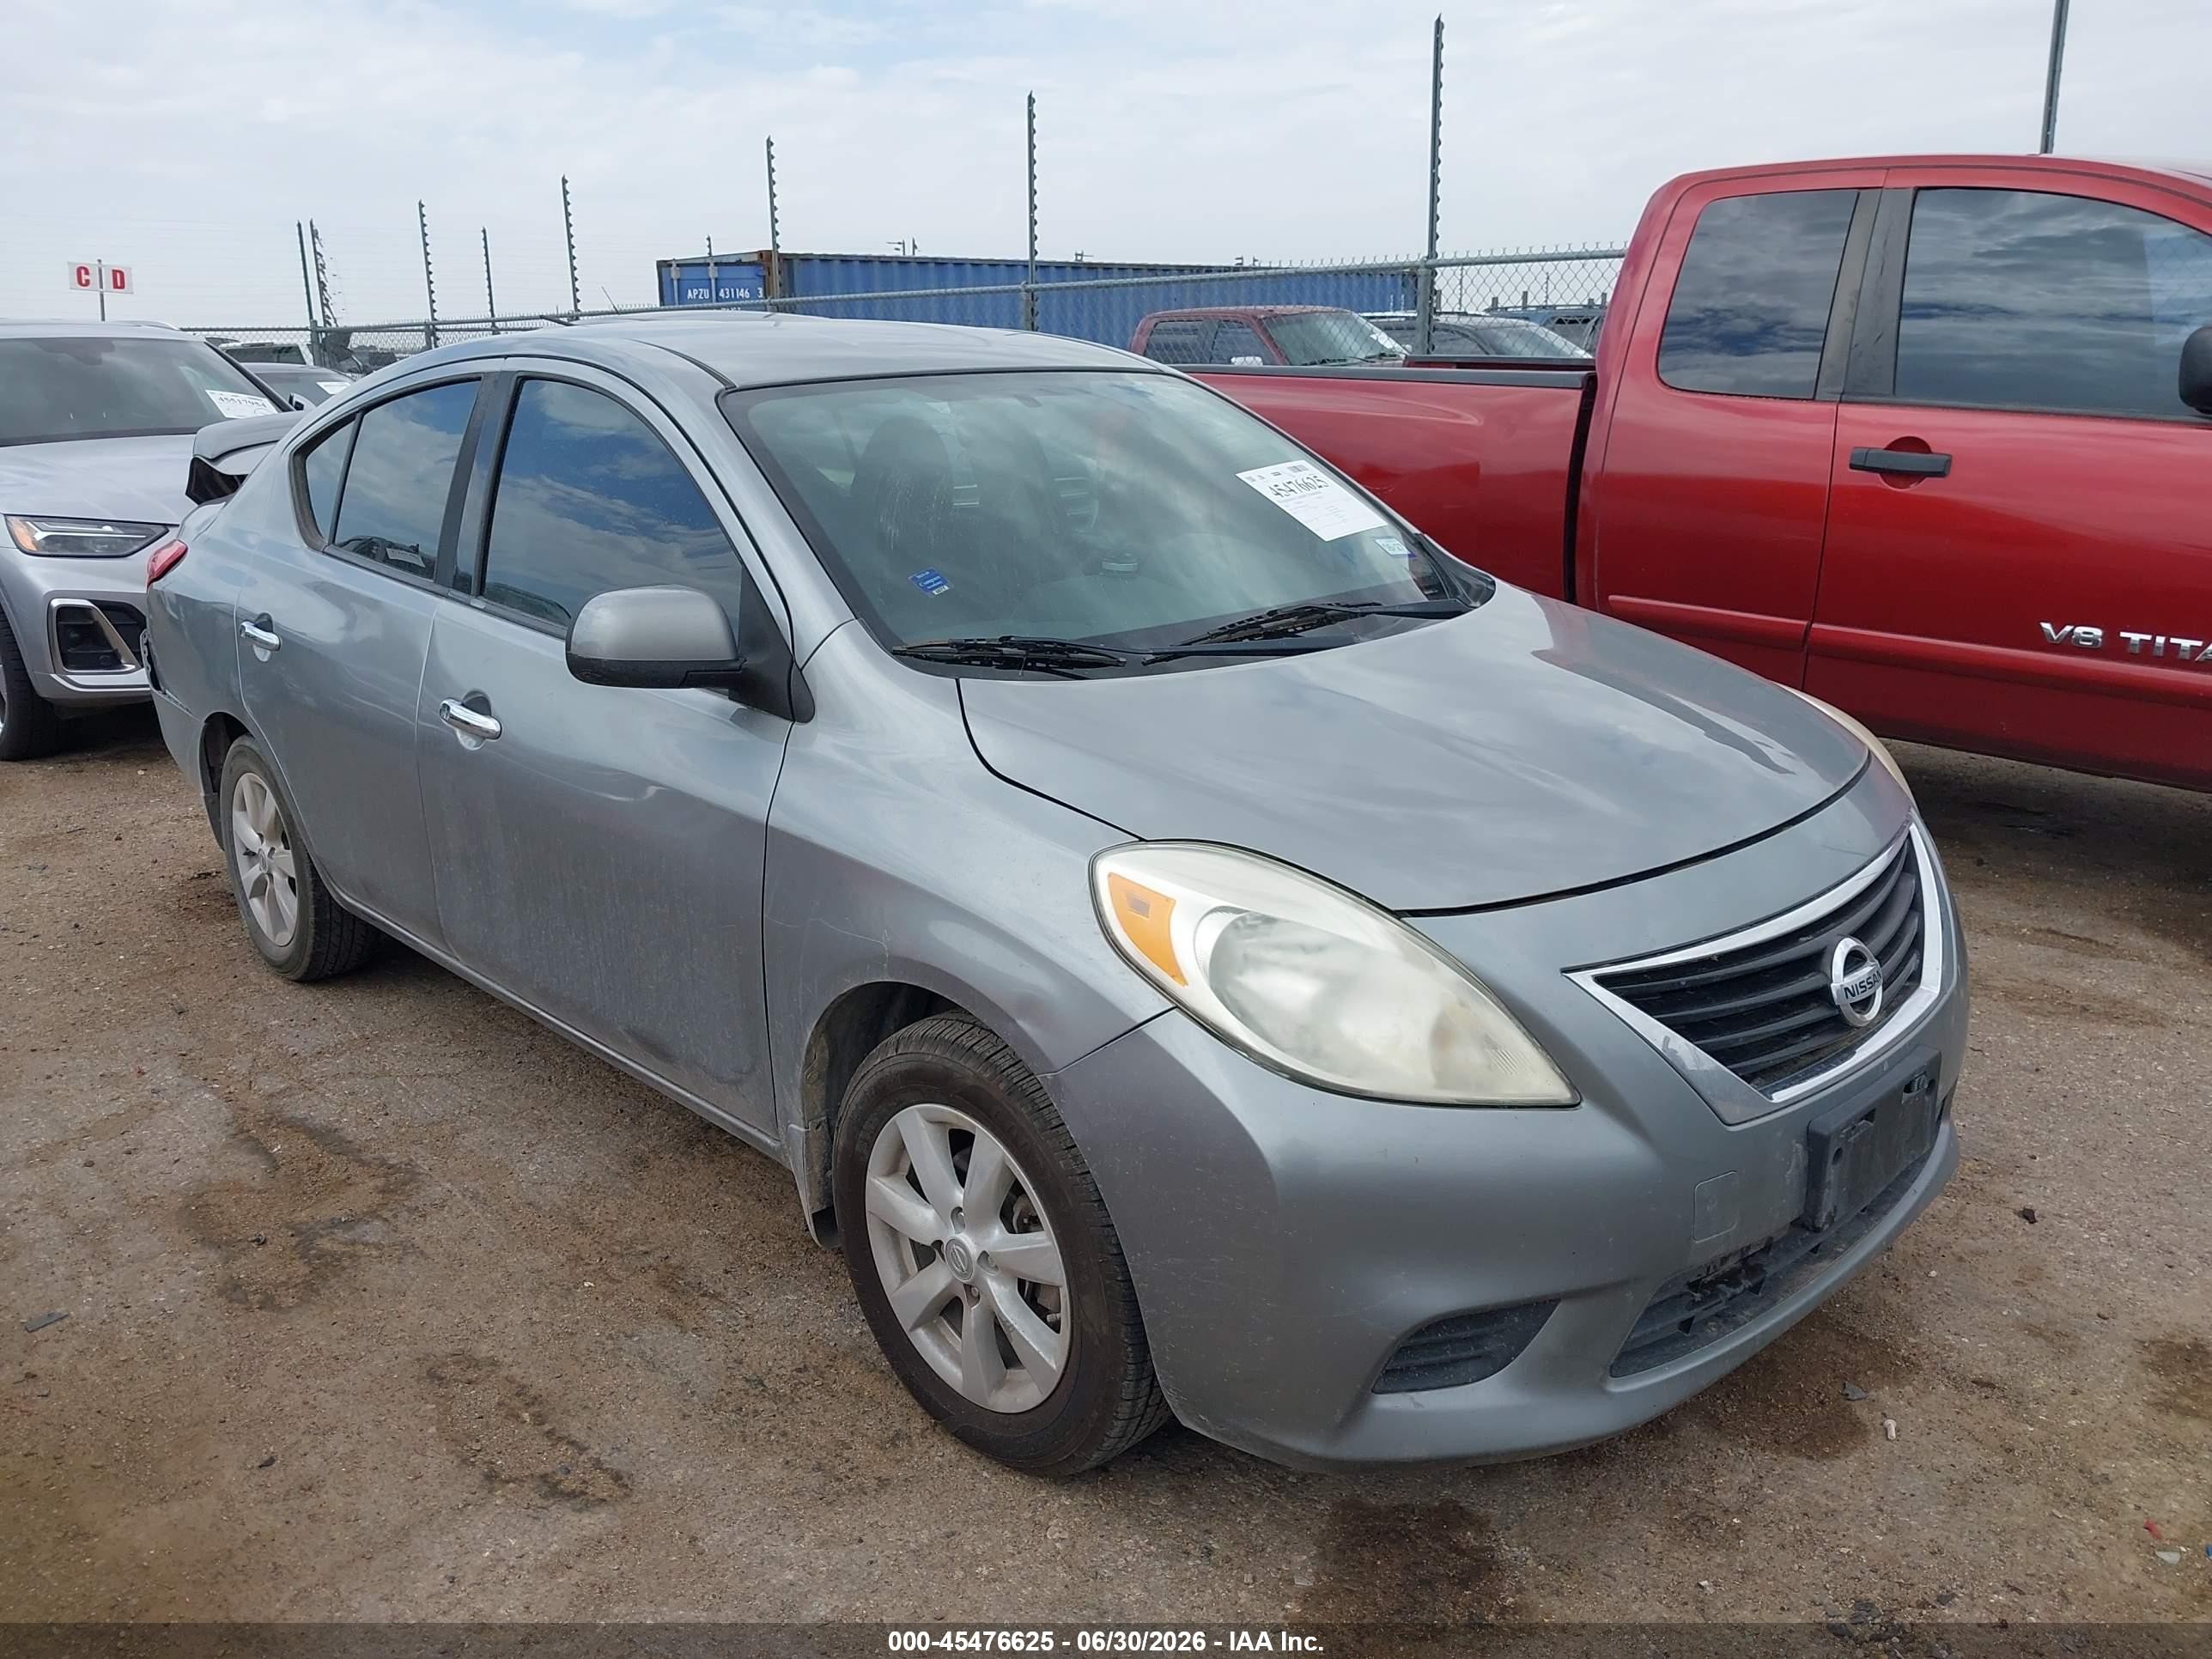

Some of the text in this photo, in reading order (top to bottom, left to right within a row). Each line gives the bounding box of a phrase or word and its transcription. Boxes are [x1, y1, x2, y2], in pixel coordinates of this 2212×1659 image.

[76, 265, 90, 287] C
[112, 269, 125, 289] D
[687, 288, 763, 300] APZU 431146 3
[1268, 475, 1329, 498] 45476625
[2039, 622, 2103, 648] V8
[1844, 969, 1882, 1000] NISSAN
